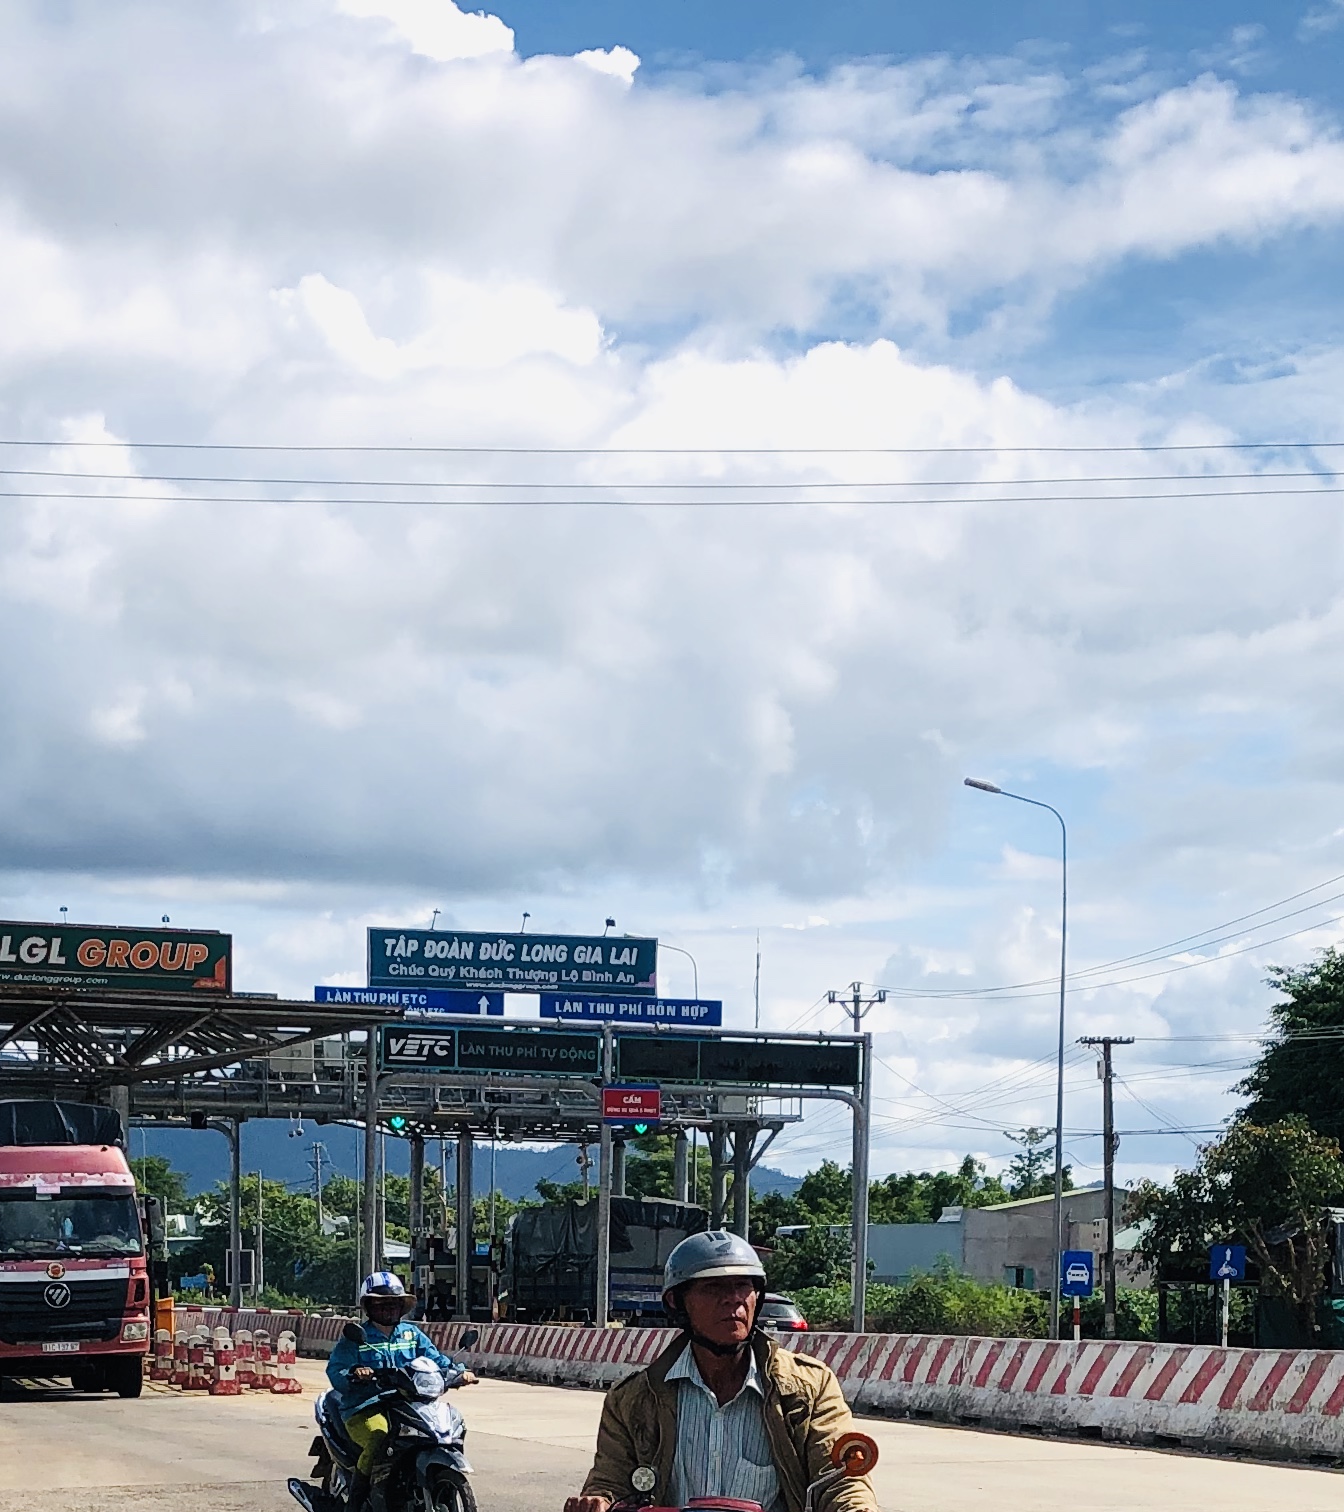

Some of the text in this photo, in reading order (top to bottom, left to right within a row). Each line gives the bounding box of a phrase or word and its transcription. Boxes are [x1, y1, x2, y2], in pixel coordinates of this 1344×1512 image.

[77, 938, 209, 971] GROUP
[384, 935, 639, 966] TẬP ĐOÀN ĐỨC LONG GIA LAI
[388, 963, 425, 977] Chúc
[428, 964, 456, 980] Quý
[459, 965, 503, 979] Khách
[506, 967, 557, 983] Thượng
[561, 969, 579, 983] Lộ
[616, 971, 635, 984] An
[326, 989, 427, 1005] LÀN THU PHÍ ETC
[555, 999, 709, 1020] LÀN THU PHÍ HỖN HỢP
[389, 1035, 451, 1060] VETC
[460, 1041, 596, 1062] LÀN THU PHÍ TỰ ĐỘNG
